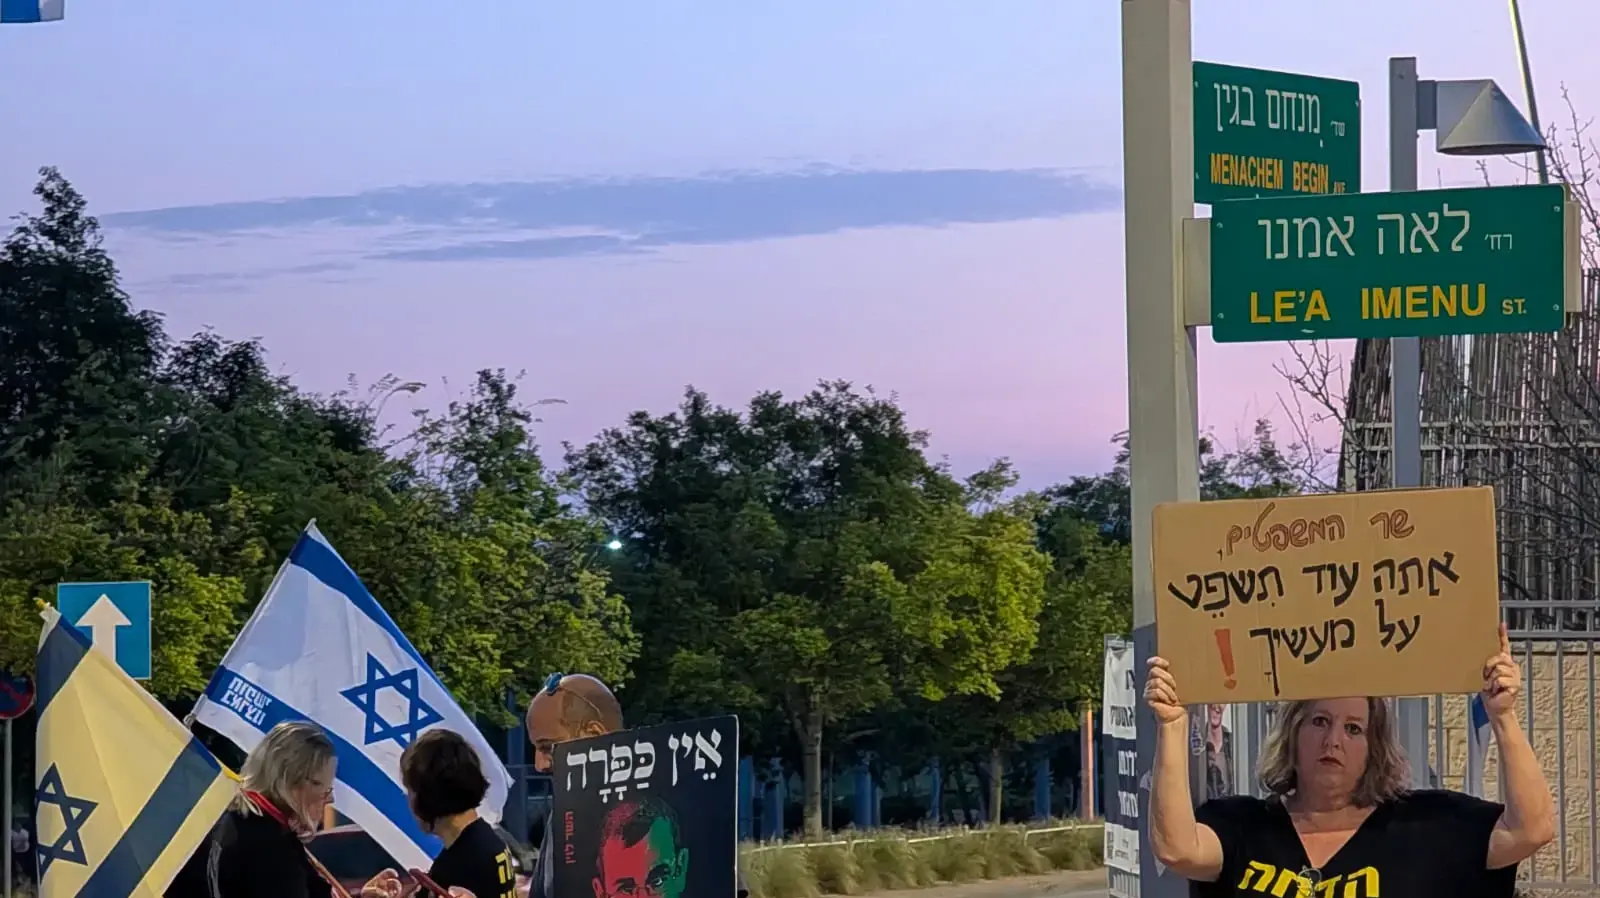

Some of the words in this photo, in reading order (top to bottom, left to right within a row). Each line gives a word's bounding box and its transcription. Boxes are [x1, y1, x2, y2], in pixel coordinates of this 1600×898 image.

[1213, 82, 1256, 132] בגין
[1265, 89, 1321, 134] מנחם
[1210, 152, 1284, 190] MENACHEM
[1293, 161, 1328, 195] BEGIN
[1258, 215, 1355, 260] אמנו
[1376, 203, 1471, 255] לאה
[1250, 290, 1331, 324] LE'A
[1361, 283, 1487, 320] IMENU
[1502, 298, 1527, 315] ST.
[1368, 508, 1415, 540] שר
[1302, 561, 1360, 608] עוד
[1373, 551, 1461, 597] אתה
[1374, 598, 1421, 653] על
